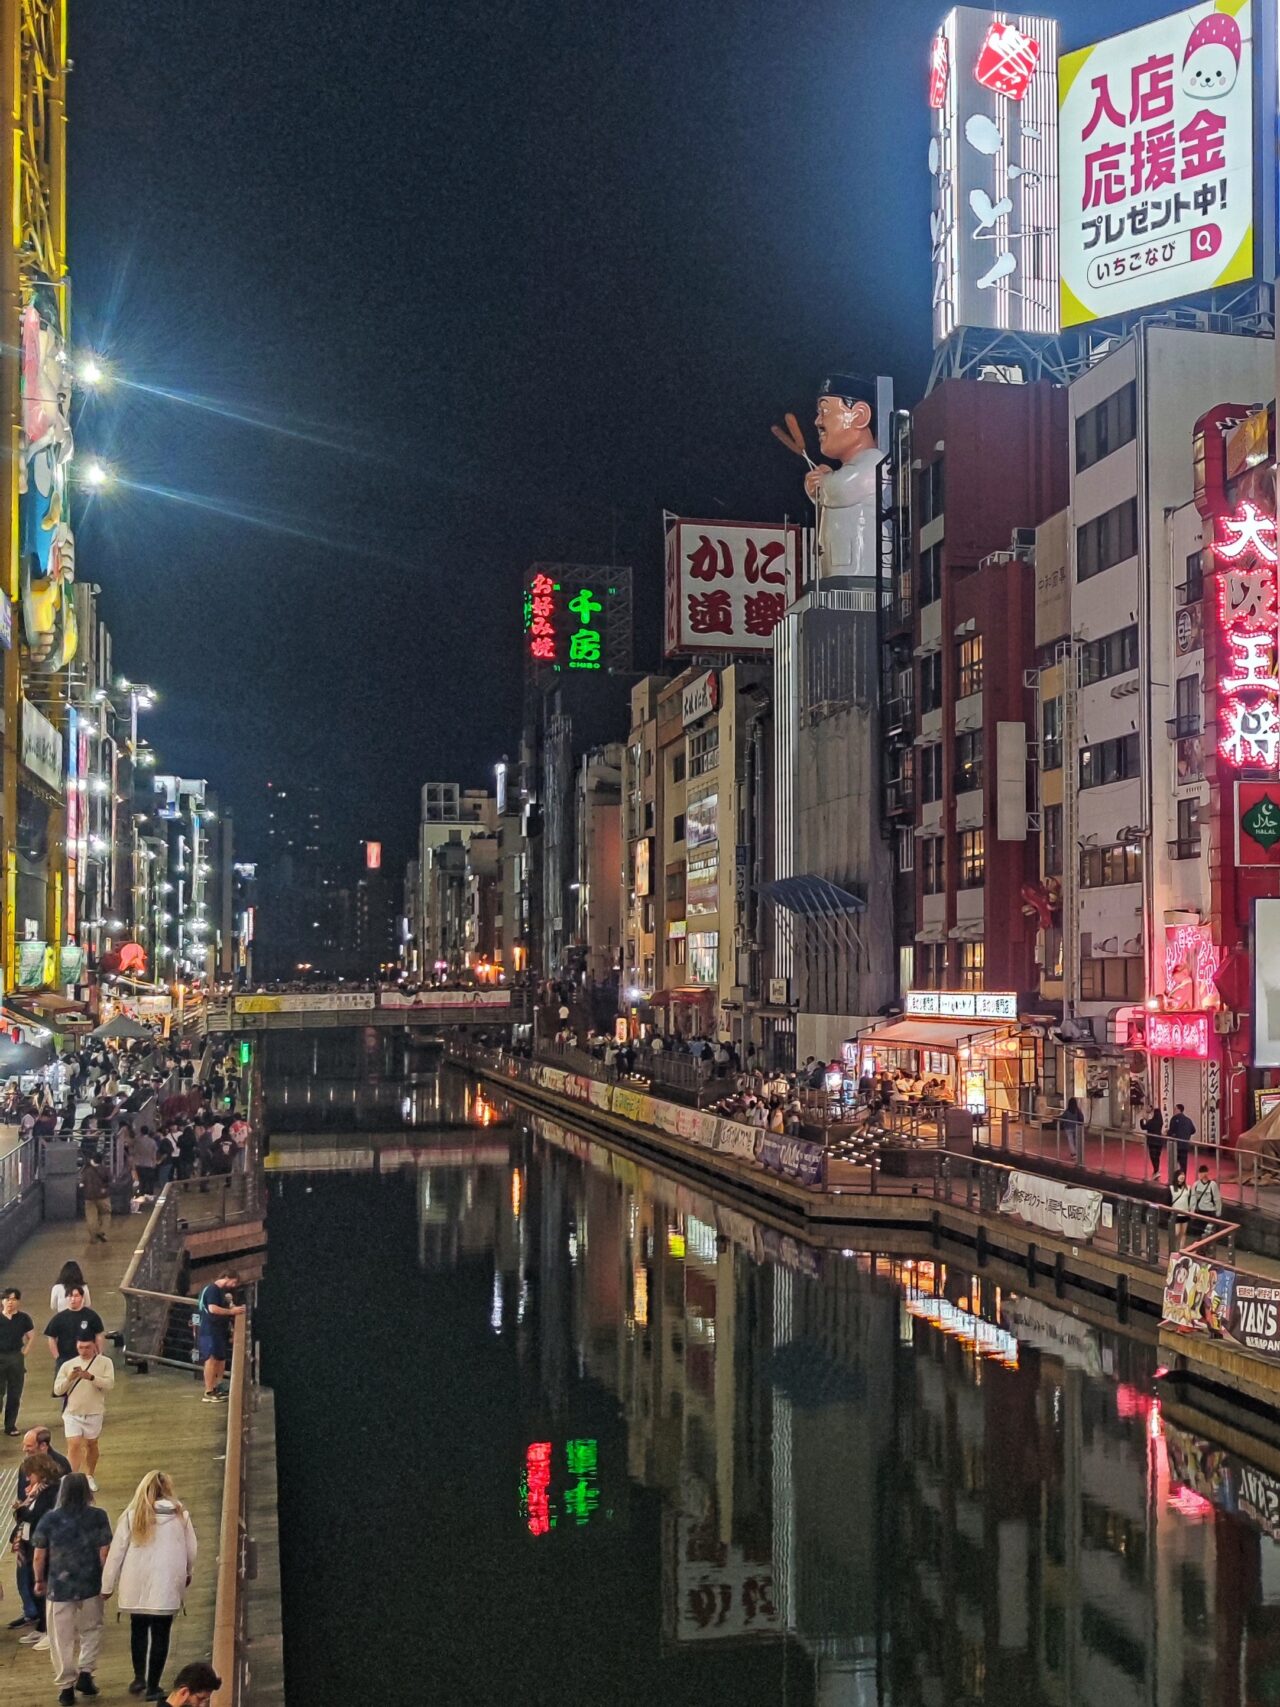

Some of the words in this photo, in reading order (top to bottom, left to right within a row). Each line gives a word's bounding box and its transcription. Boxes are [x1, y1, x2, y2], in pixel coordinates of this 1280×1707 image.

[1082, 53, 1174, 144] 入店
[1082, 109, 1227, 213] 応援金
[1082, 178, 1228, 250] プレゼント中!
[1097, 241, 1176, 280] いちごなび
[687, 535, 785, 584] かに
[531, 573, 555, 659] お好み焼
[568, 589, 602, 661] 千房
[1213, 501, 1280, 766] 大阪王将
[1237, 1301, 1278, 1337] VANS
